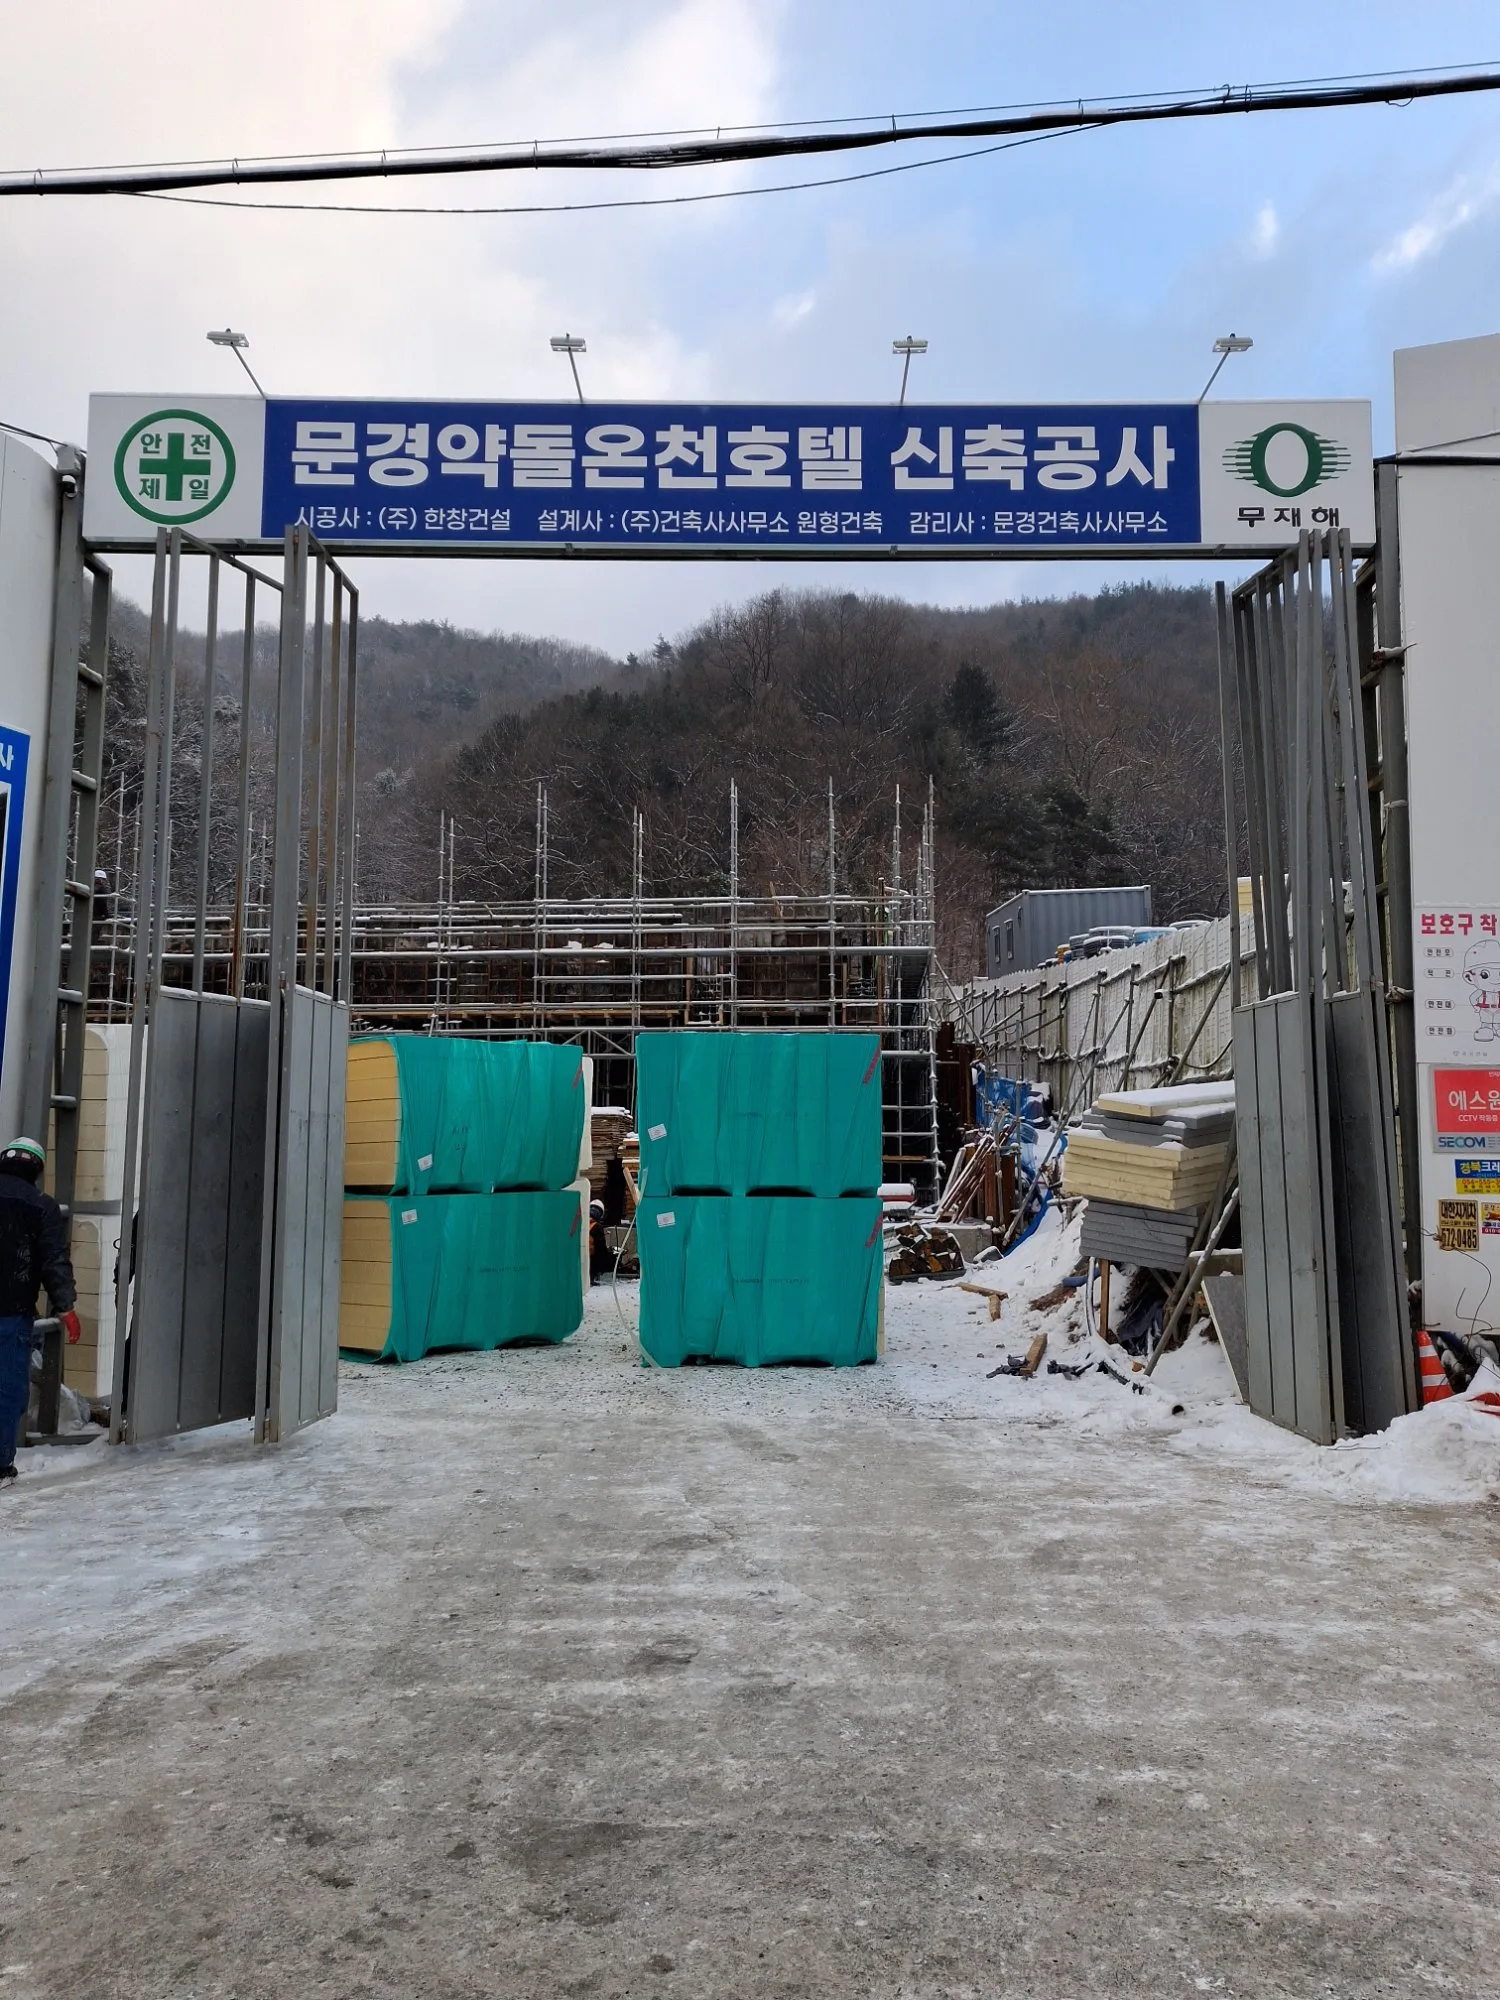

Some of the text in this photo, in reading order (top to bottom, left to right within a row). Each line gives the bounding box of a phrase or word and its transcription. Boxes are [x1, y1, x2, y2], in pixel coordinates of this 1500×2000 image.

[291, 421, 1176, 491] 문경약돌온천호텔 신축공사
[294, 506, 360, 529] 시공사
[424, 507, 511, 531] 한창건설
[538, 509, 603, 532] 설계사
[797, 511, 883, 534] 원형건축
[909, 511, 975, 534] 감리사
[993, 511, 1168, 534] 문경건축사사무소
[1237, 507, 1340, 528] 무재해
[1421, 913, 1474, 936] 보호구
[1438, 1136, 1487, 1149] SECOM
